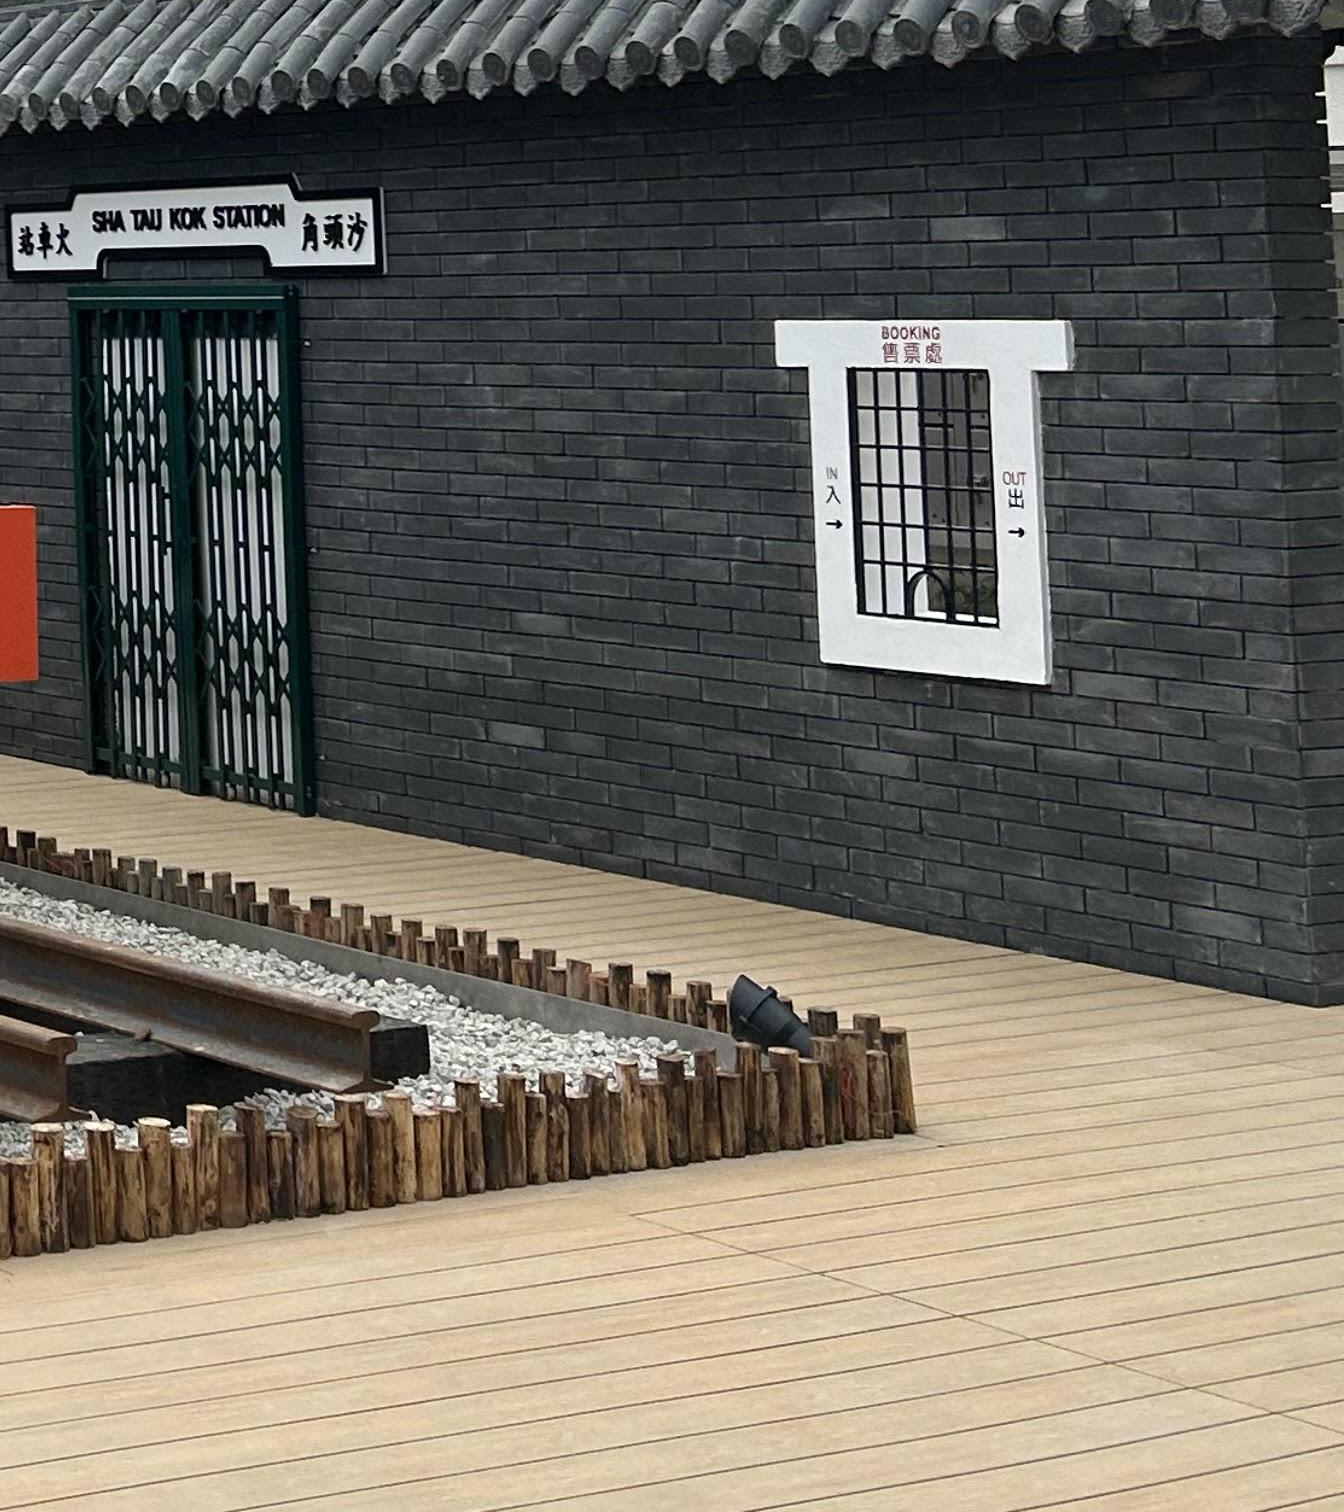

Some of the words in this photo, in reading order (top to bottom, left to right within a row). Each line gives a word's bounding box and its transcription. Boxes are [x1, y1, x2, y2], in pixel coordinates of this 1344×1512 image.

[91, 209, 126, 233] SHA
[130, 207, 163, 232] TAU
[169, 205, 207, 230] KOK
[212, 203, 285, 229] STATION
[881, 326, 941, 341] BOOKING
[882, 342, 943, 363] 售票處
[825, 467, 838, 480] IN
[1002, 471, 1027, 486] OUT
[825, 485, 842, 505] 入
[1007, 489, 1025, 509] 出
